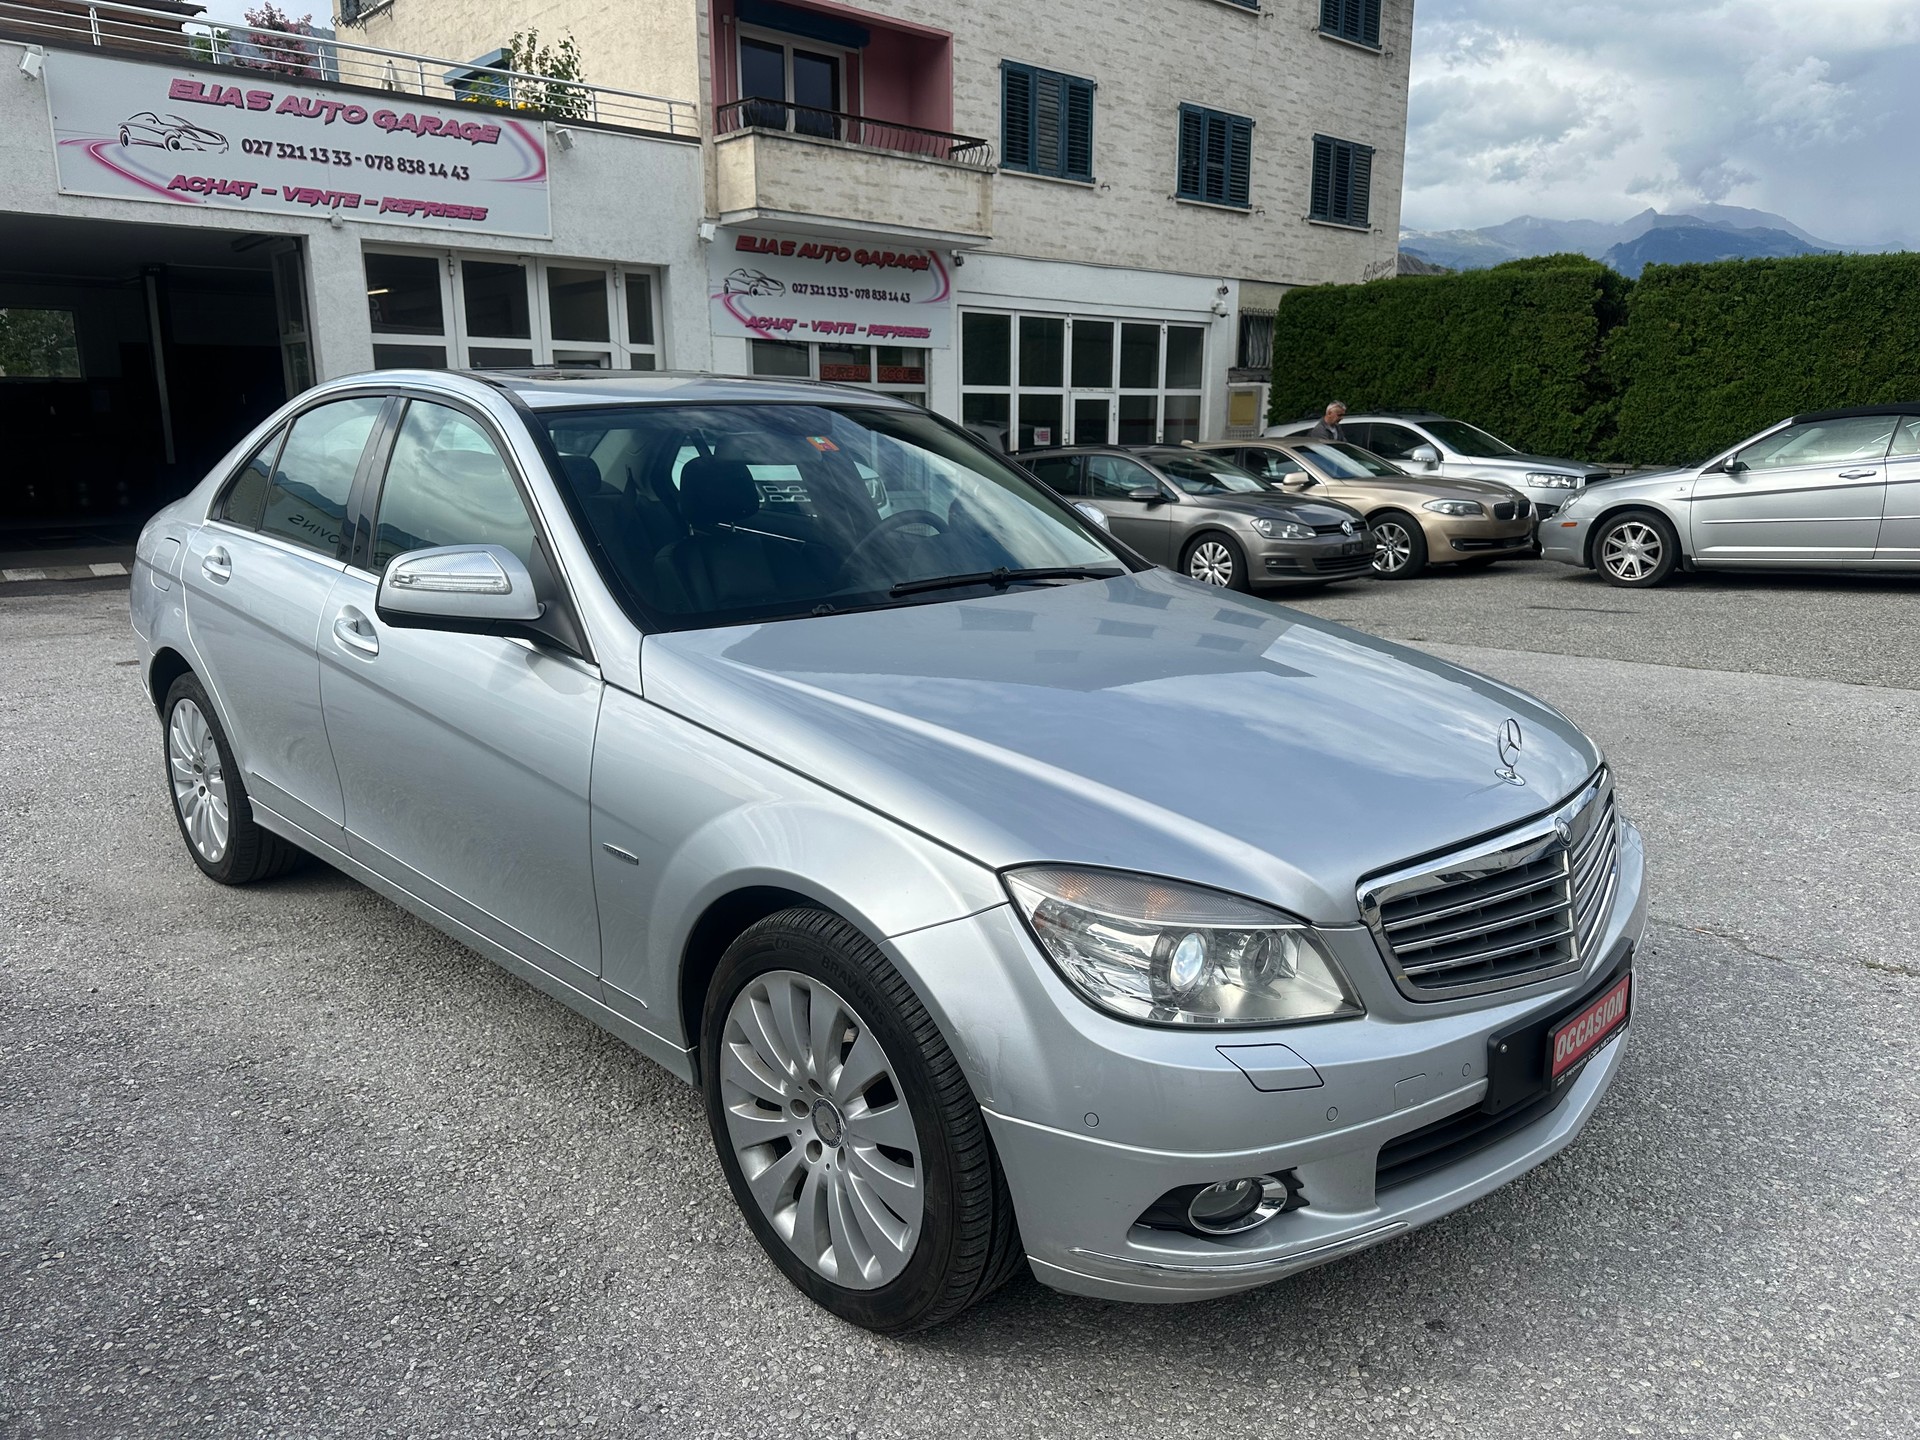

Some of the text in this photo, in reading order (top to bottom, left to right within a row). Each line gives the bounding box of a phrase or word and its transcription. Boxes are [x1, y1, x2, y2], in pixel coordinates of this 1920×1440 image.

[168, 78, 501, 145] ELIAS AUTO GARAGE
[241, 138, 273, 157] 027
[276, 142, 308, 160] 321
[310, 147, 330, 164] 13
[332, 150, 352, 167] 33
[364, 154, 395, 172] 078
[397, 157, 426, 175] 838
[428, 163, 448, 179] 14
[451, 166, 470, 181] 43
[167, 174, 258, 201] ACHAT
[282, 185, 362, 210] VENTE
[379, 196, 489, 221] REPRISES
[735, 235, 932, 273] ELIAS AUTO GARAGE
[791, 282, 809, 295] 027
[809, 284, 826, 297] 321
[826, 286, 838, 298] 13
[838, 286, 849, 298] 33
[854, 288, 871, 300] 078
[871, 289, 888, 301] 838
[888, 291, 899, 303] 14
[900, 292, 911, 303] 43
[745, 315, 798, 334] ACHAT
[811, 320, 858, 337] VENTE
[866, 323, 932, 340] REPRISES
[821, 364, 869, 379] BUREAU
[1556, 987, 1625, 1063] OCCASION
